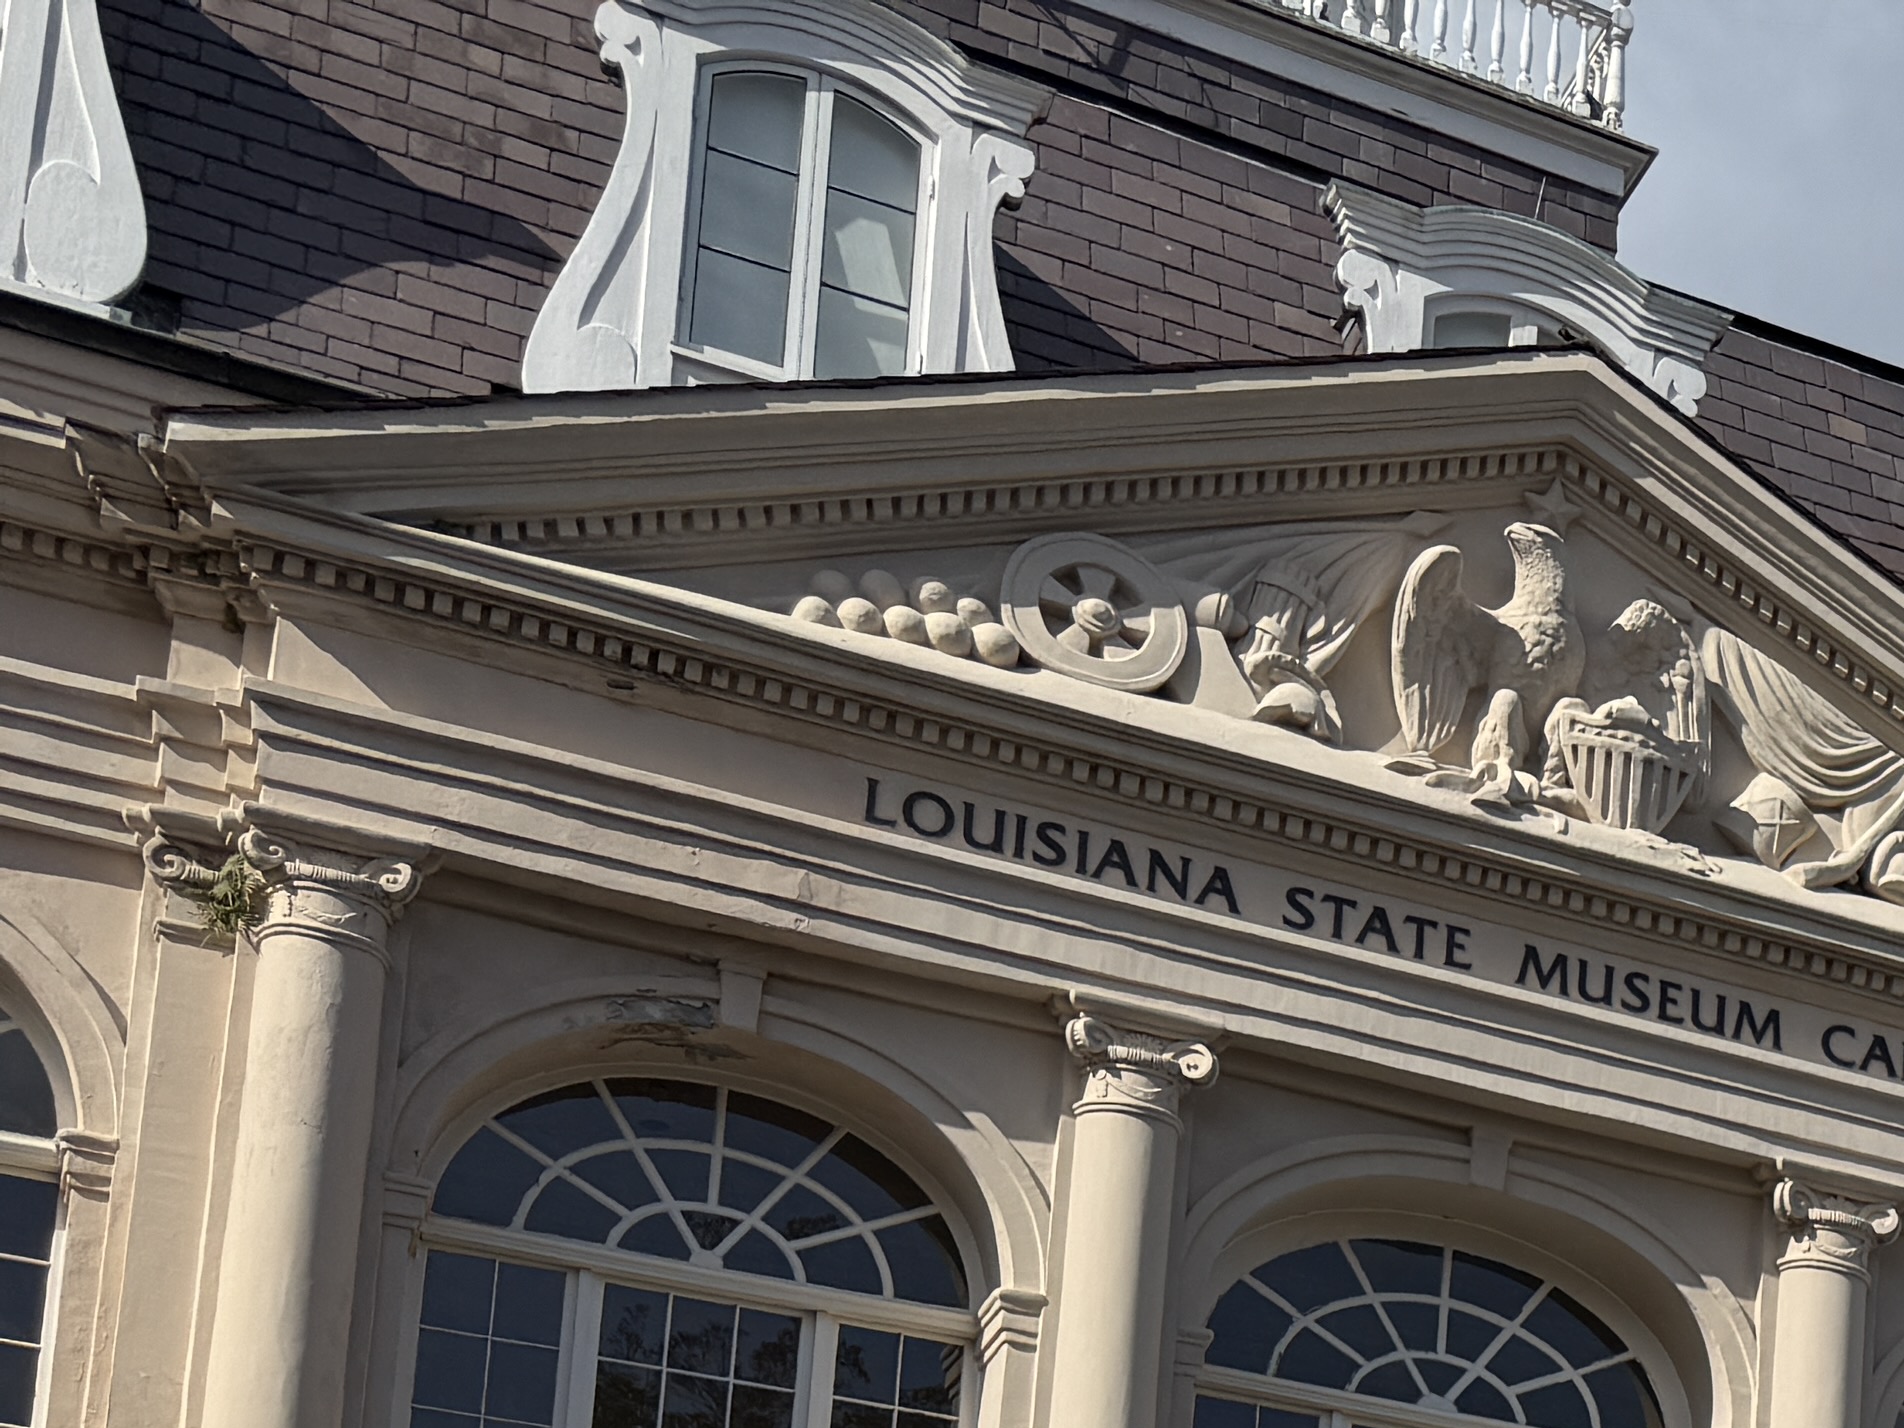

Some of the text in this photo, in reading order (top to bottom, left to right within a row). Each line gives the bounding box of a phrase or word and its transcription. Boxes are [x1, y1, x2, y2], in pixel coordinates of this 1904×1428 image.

[864, 775, 1242, 916] LOUISIANA
[1281, 885, 1473, 972] STATE
[1514, 942, 1783, 1052] MUSEUM
